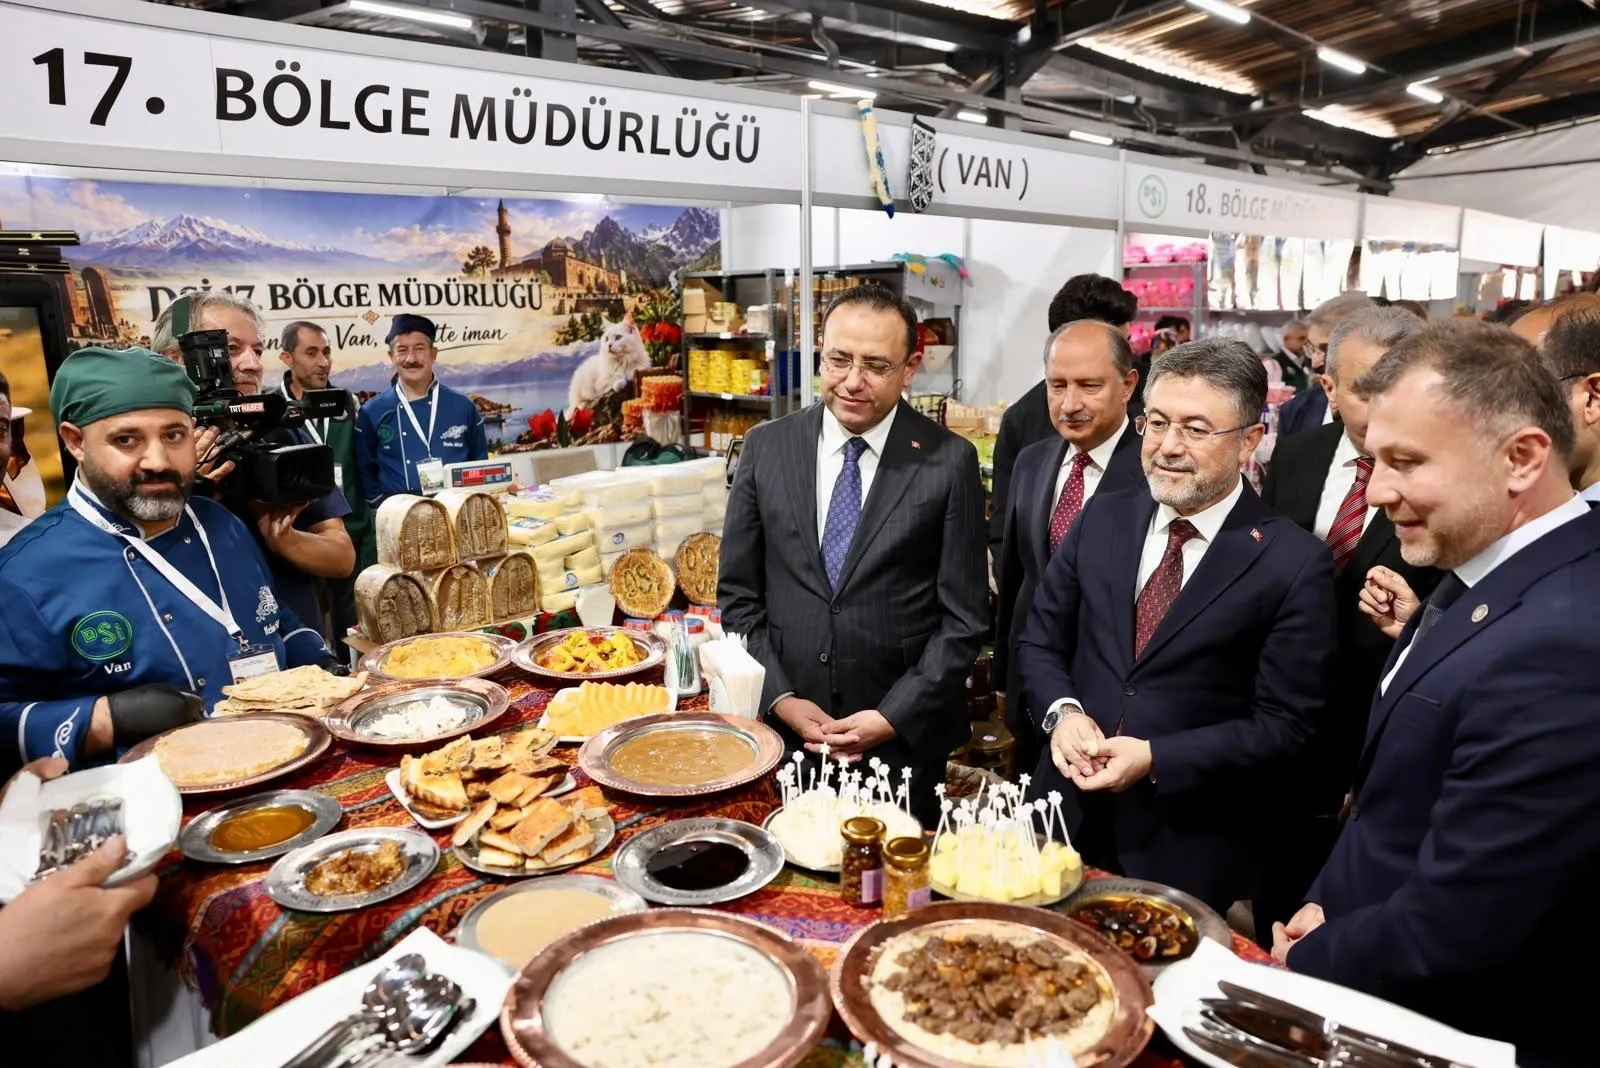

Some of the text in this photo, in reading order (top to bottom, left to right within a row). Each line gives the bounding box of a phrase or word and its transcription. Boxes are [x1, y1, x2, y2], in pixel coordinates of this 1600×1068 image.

[32, 47, 761, 164] 17. BÖLGE MÜDÜRLÜĞÜ
[1186, 183, 1212, 215] 18.
[1220, 188, 1268, 221] BÖLGE
[269, 277, 372, 311] BÖLGE
[378, 277, 543, 311] MÜDÜRLÜĞÜ
[335, 323, 378, 350] Van,
[229, 402, 264, 414] TRT HABER
[104, 660, 132, 676] Van
